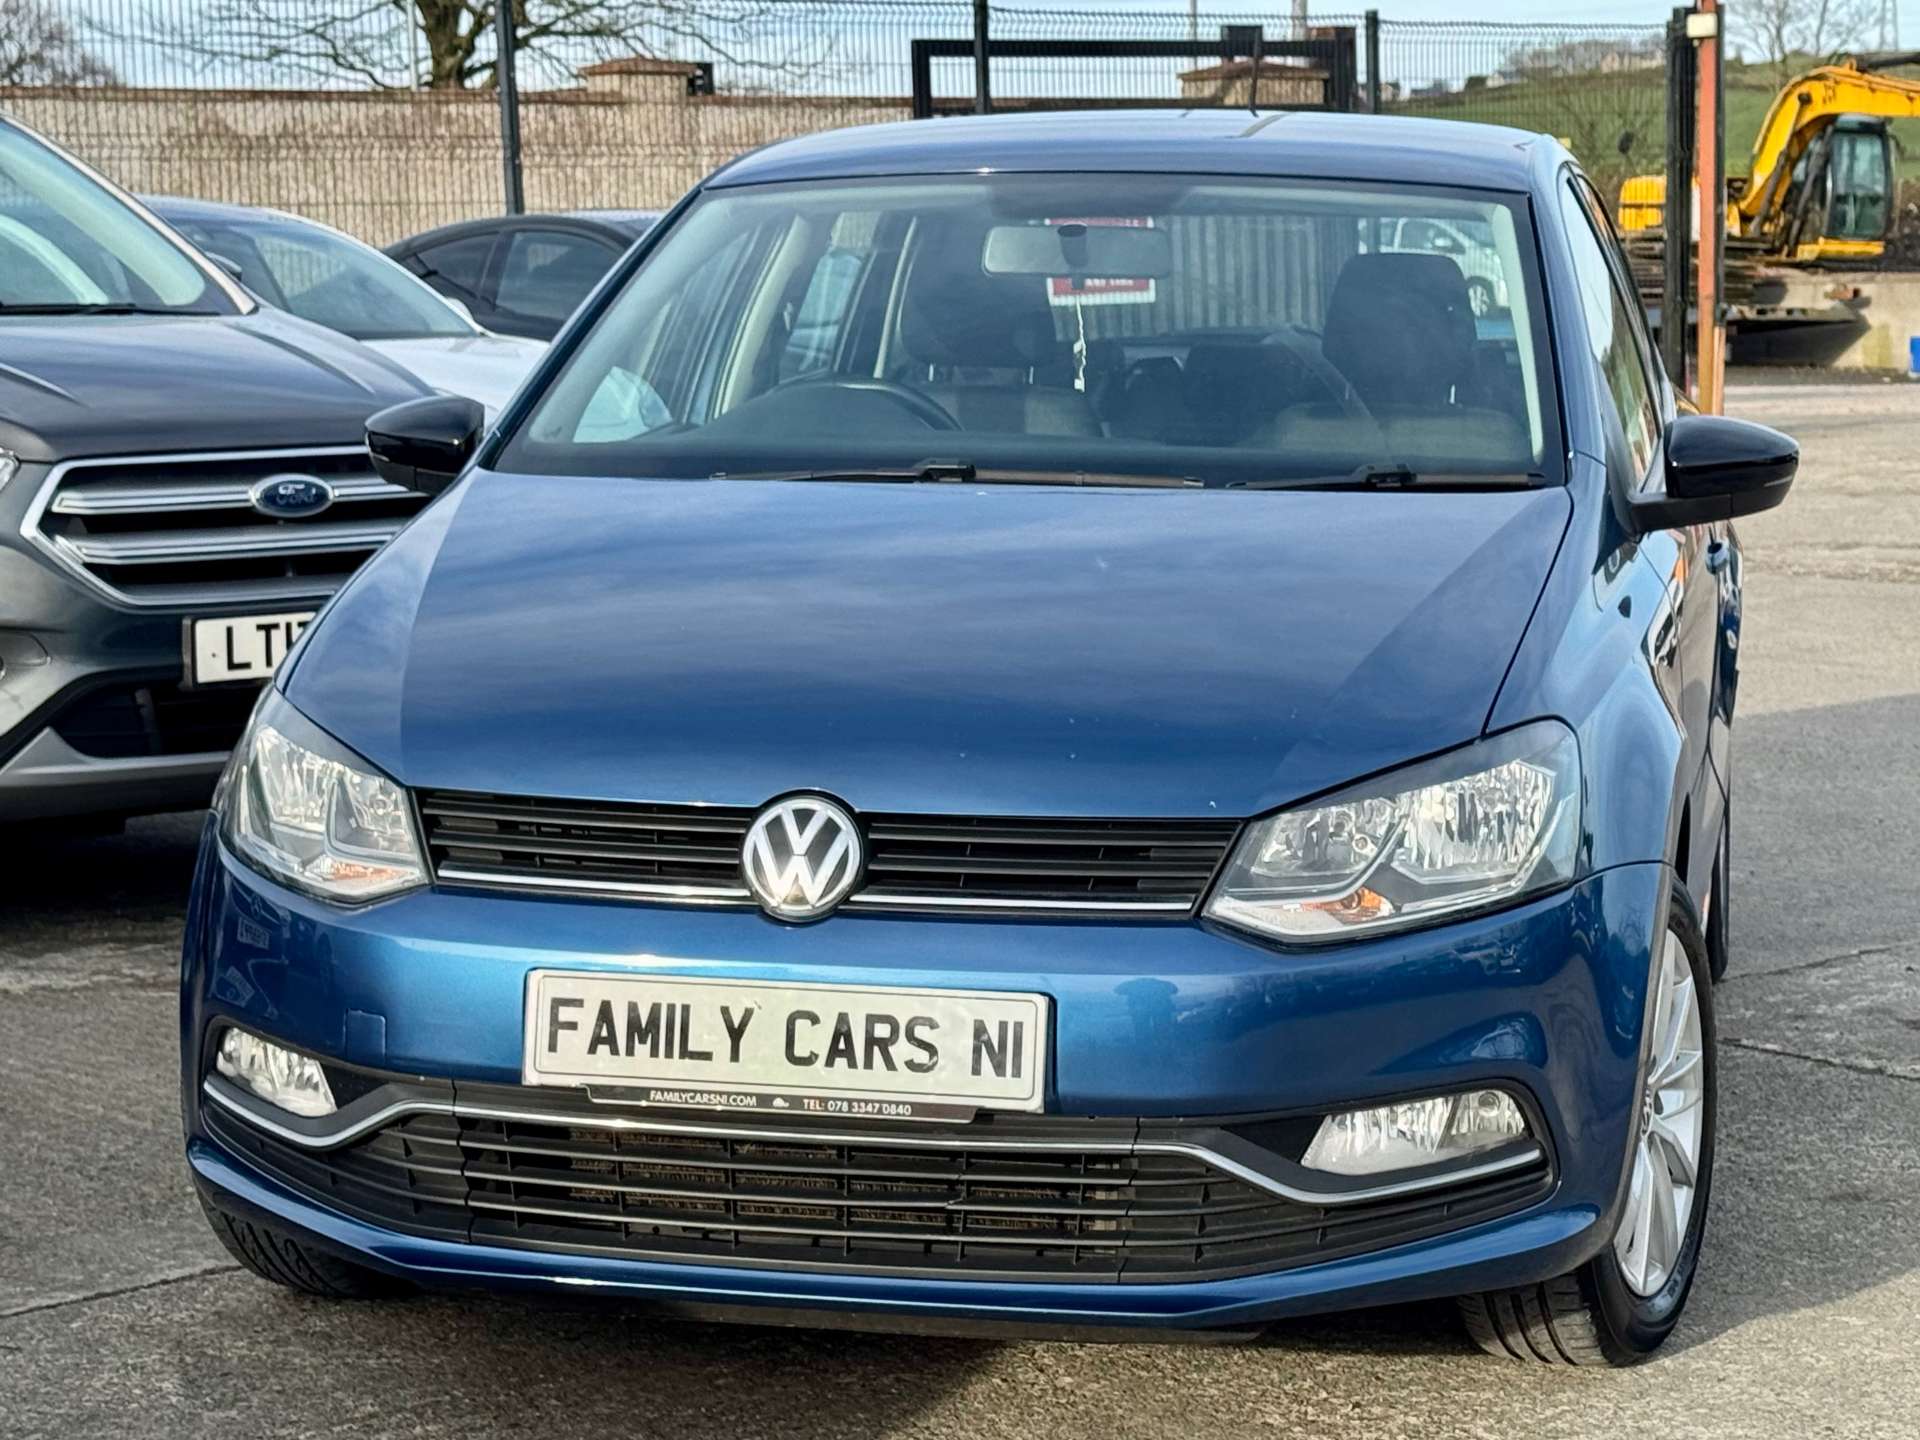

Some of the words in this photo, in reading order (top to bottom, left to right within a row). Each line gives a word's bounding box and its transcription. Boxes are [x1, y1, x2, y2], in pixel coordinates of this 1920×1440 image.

[548, 997, 754, 1063] FAMILY
[785, 1010, 940, 1073] CARS
[971, 1019, 1024, 1078] NI
[650, 1090, 757, 1107] FAMILYCARSNI.COM
[803, 1099, 825, 1110] TEL:
[827, 1100, 849, 1112] 078
[852, 1102, 880, 1113] 3347
[881, 1103, 912, 1115] 0840
